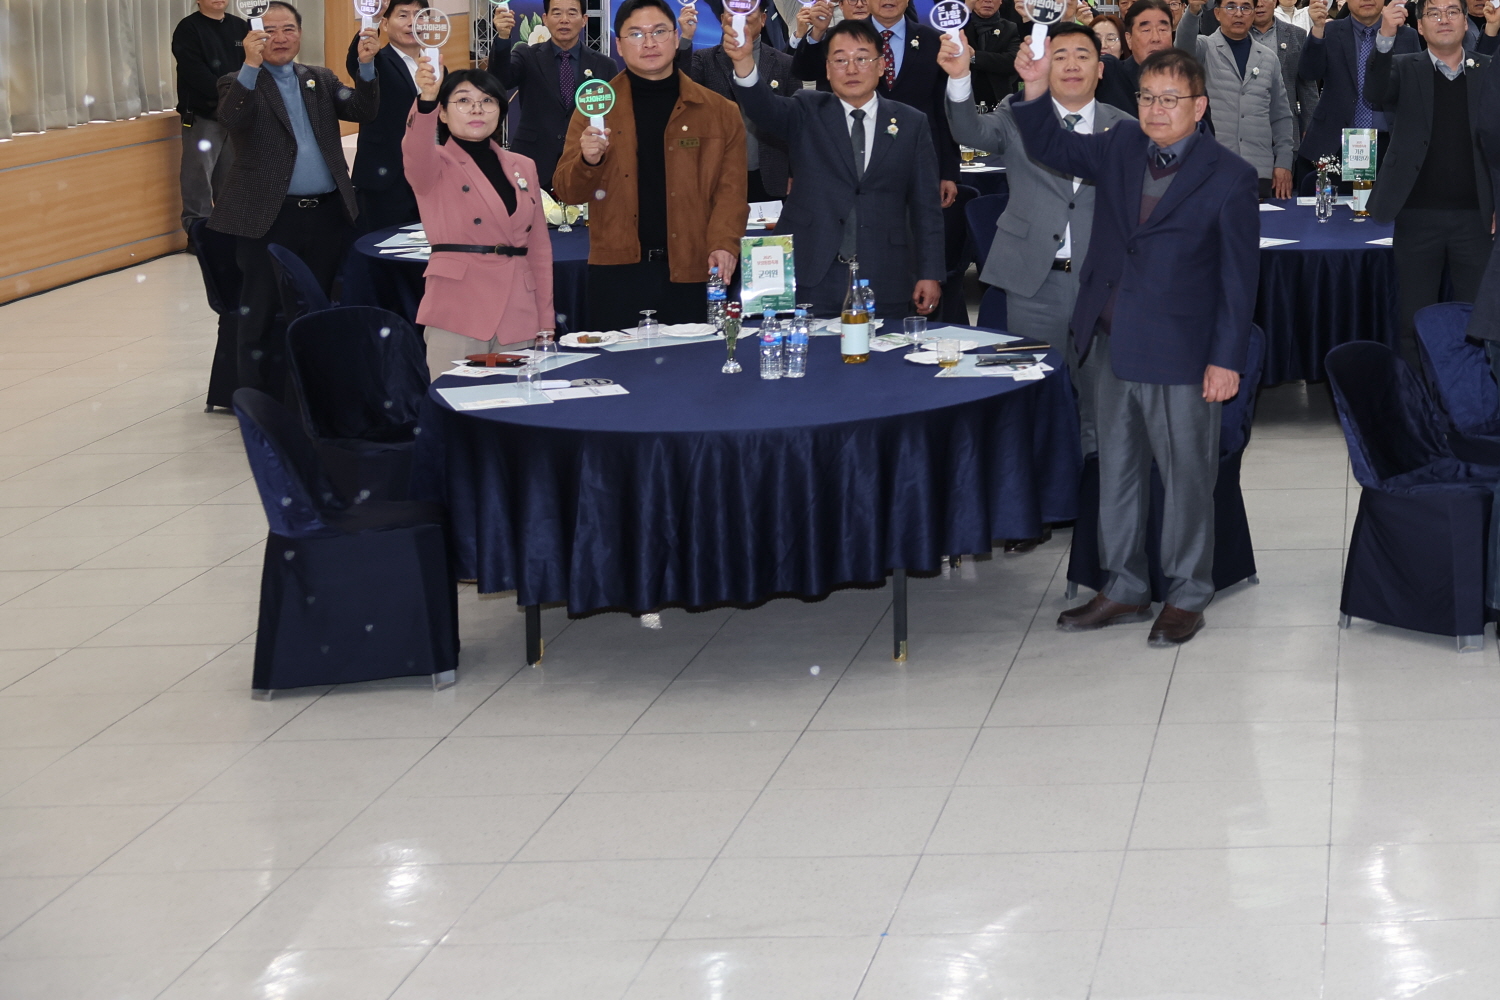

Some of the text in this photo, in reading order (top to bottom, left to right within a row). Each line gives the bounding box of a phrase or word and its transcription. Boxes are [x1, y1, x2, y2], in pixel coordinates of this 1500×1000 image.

[938, 10, 960, 20] 다향
[416, 24, 447, 32] 녹차마라톤
[579, 93, 611, 103] 녹차마라톤
